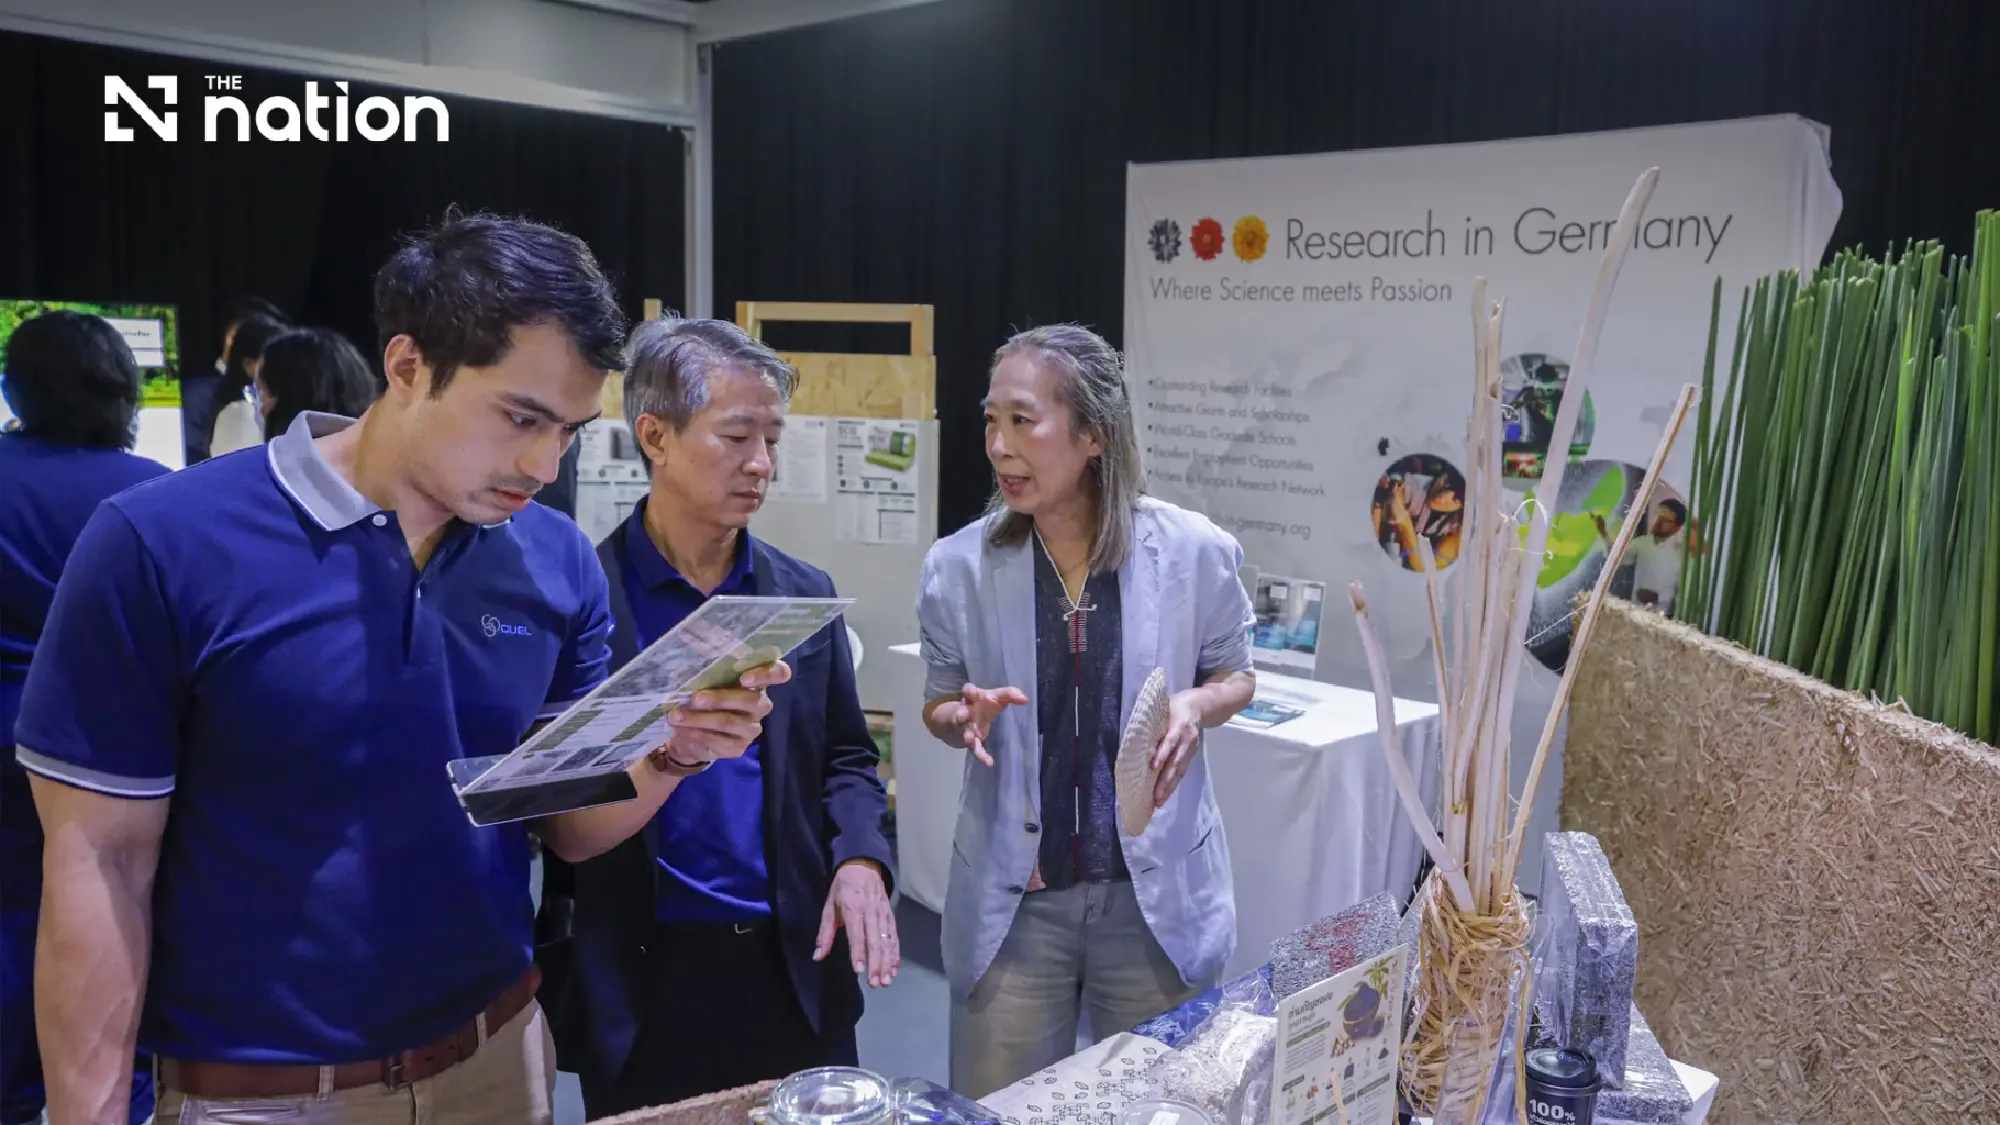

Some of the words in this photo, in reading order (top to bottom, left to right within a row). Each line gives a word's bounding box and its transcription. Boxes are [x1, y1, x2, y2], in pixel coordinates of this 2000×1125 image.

[1286, 209, 1446, 260] Research
[1464, 216, 1494, 256] in
[1150, 276, 1213, 301] Where
[1219, 277, 1296, 302] Science
[1302, 279, 1363, 301] meets
[1371, 276, 1453, 301] Passion
[1229, 405, 1247, 418] and
[1258, 430, 1297, 445] Schools
[1249, 453, 1314, 472] Opportunities
[1236, 475, 1278, 492] Research
[1282, 480, 1326, 498] Network
[1529, 1098, 1576, 1121] 100%
